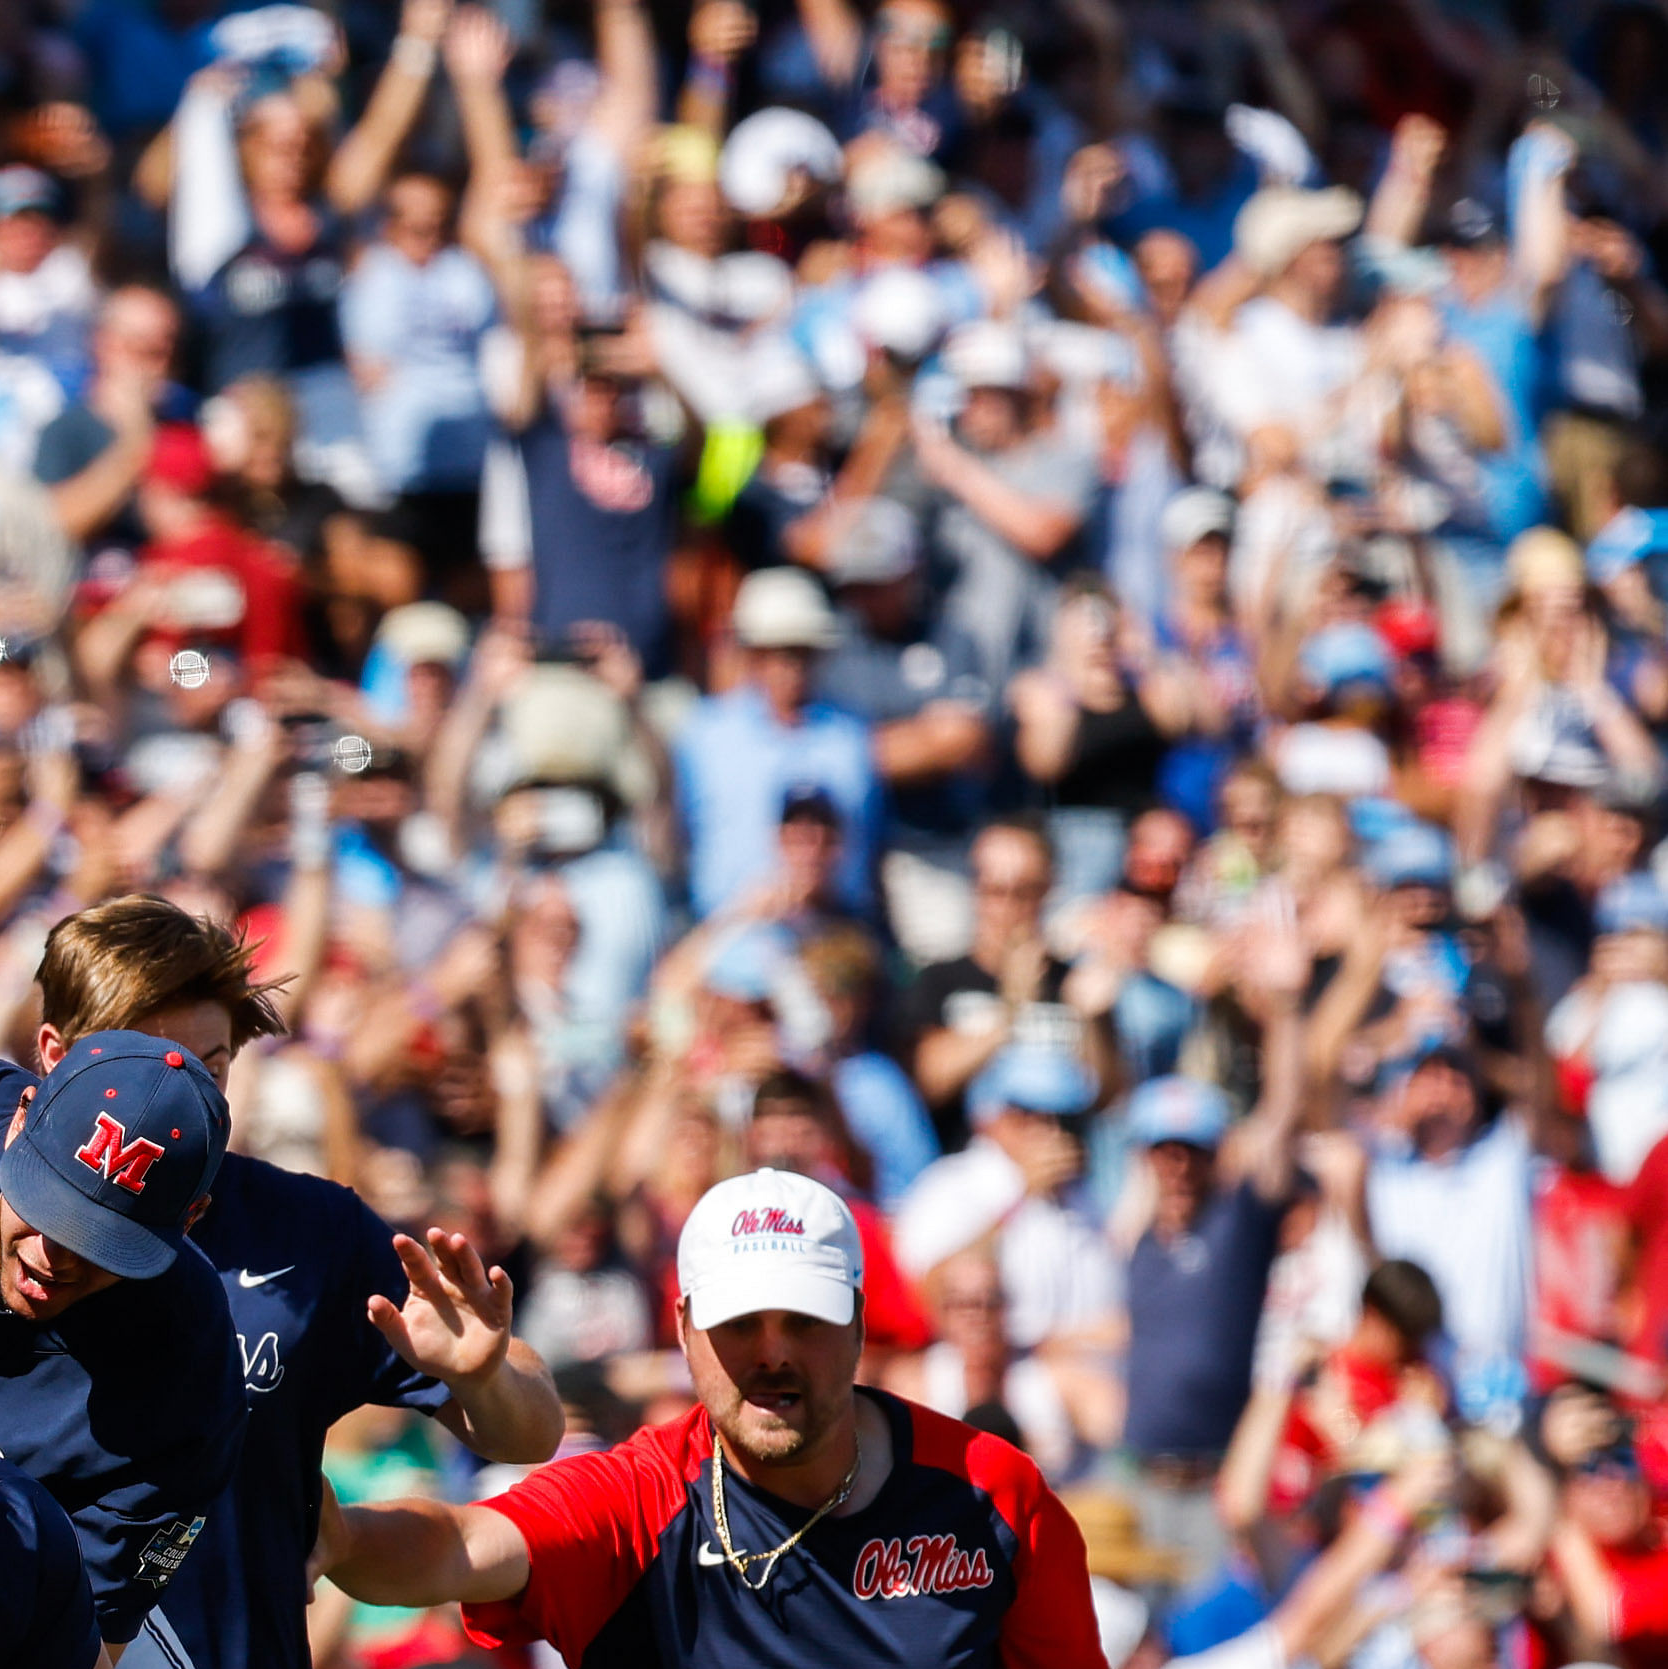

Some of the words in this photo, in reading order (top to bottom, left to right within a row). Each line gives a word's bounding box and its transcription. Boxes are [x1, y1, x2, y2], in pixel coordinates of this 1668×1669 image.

[74, 1110, 166, 1195] M
[733, 1239, 807, 1254] BASEBALL
[854, 1537, 912, 1600] Ole
[907, 1533, 995, 1597] Miss
